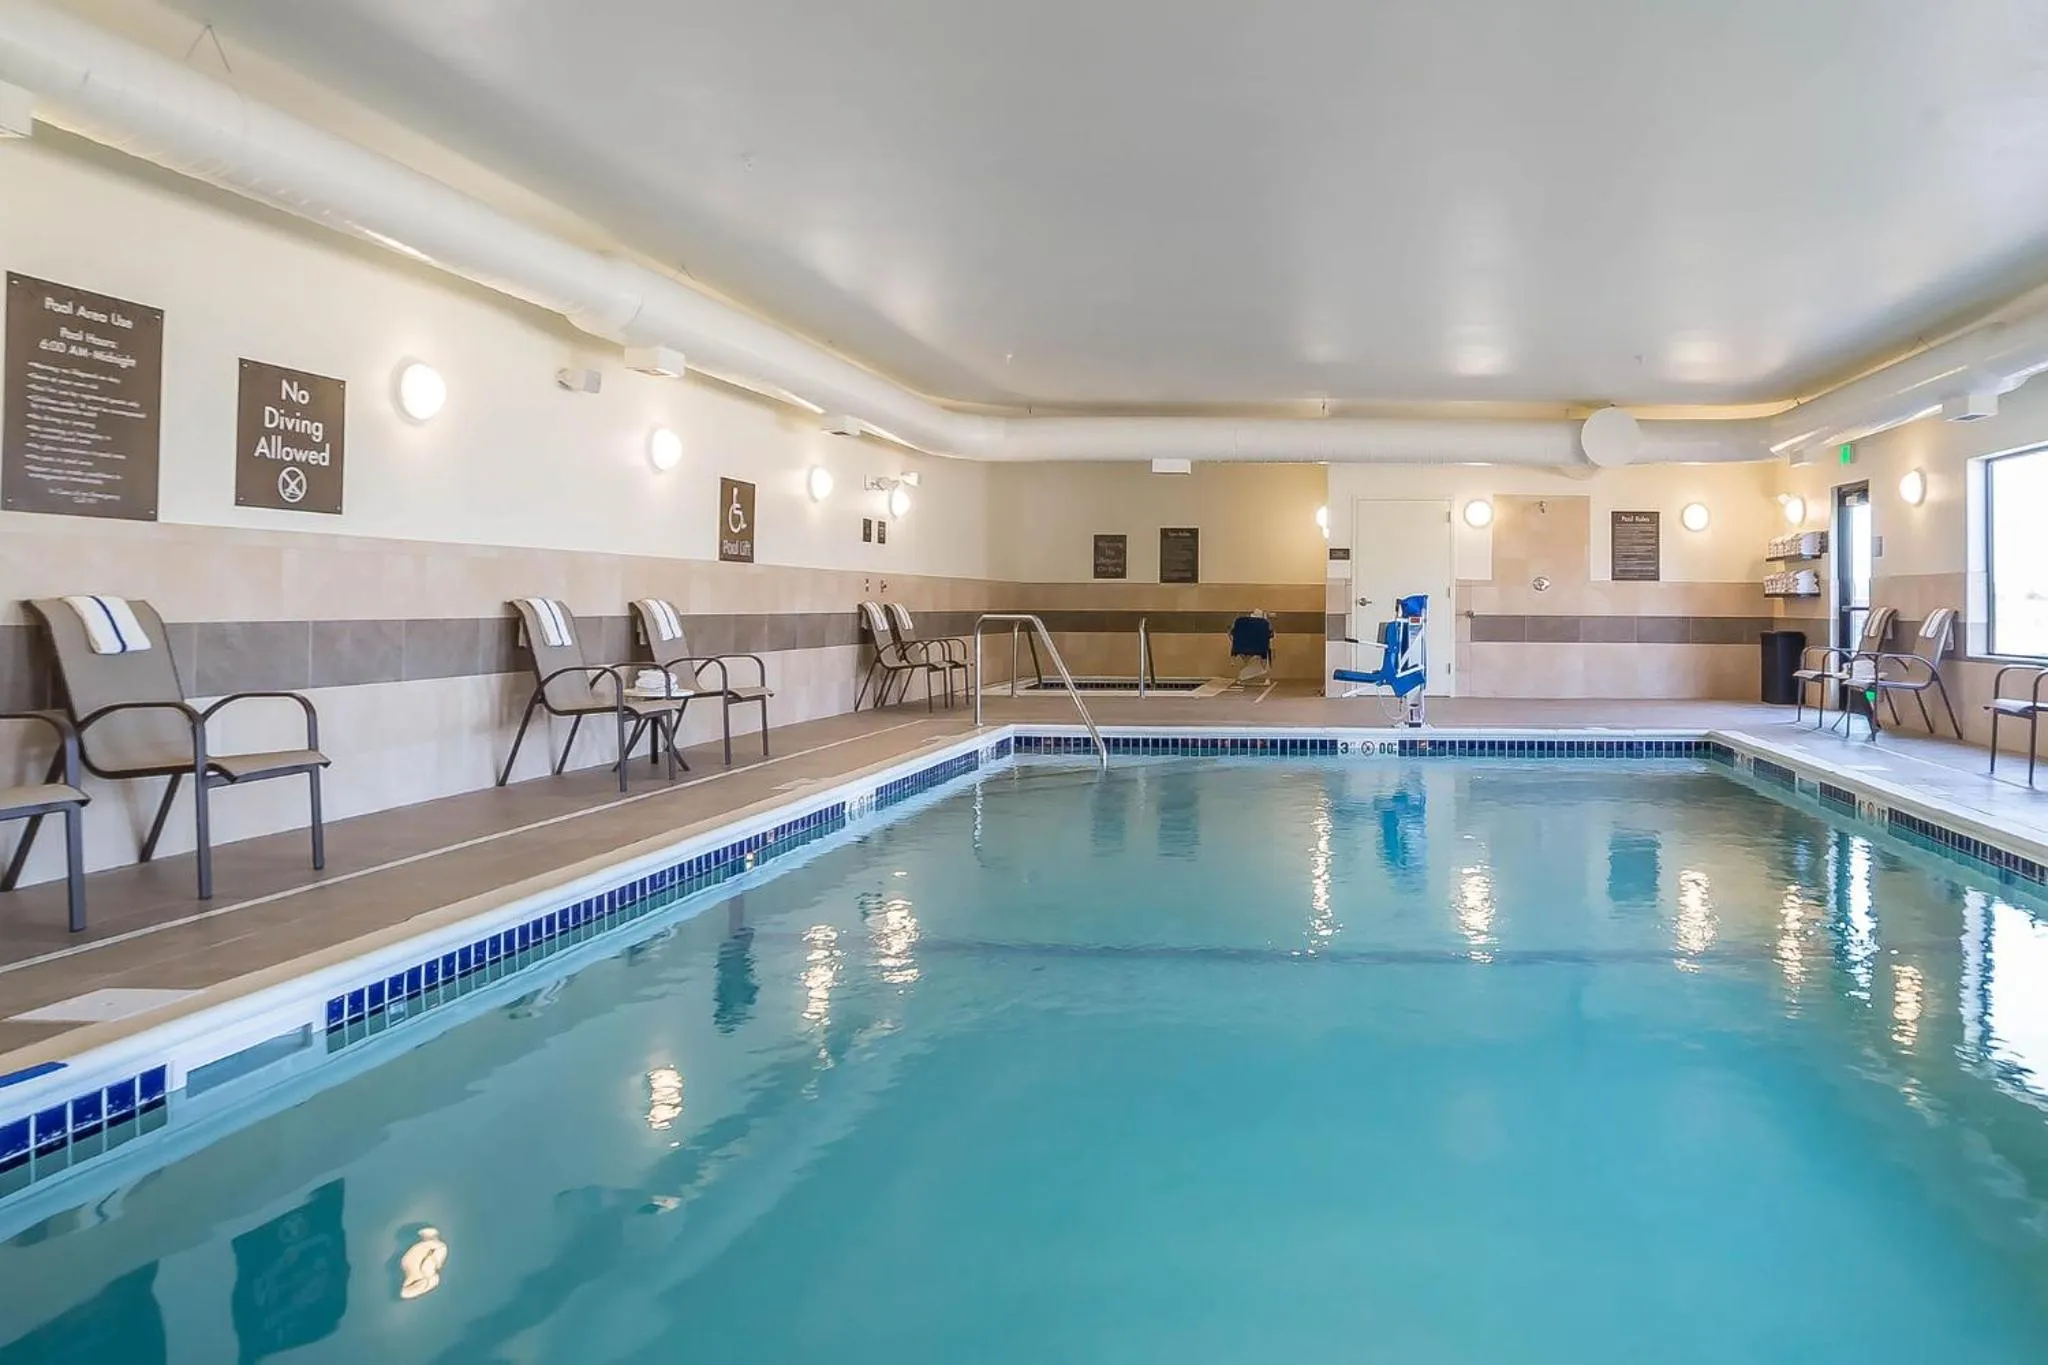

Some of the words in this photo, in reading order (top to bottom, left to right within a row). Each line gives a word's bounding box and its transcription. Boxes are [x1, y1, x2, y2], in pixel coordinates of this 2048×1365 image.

[44, 297, 73, 315] Pool
[76, 305, 108, 324] Area
[111, 312, 134, 329] Use
[59, 327, 83, 342] Pool
[280, 379, 310, 405] No
[264, 406, 323, 443] Diving
[253, 435, 330, 467] Allowed
[723, 540, 739, 555] Pool
